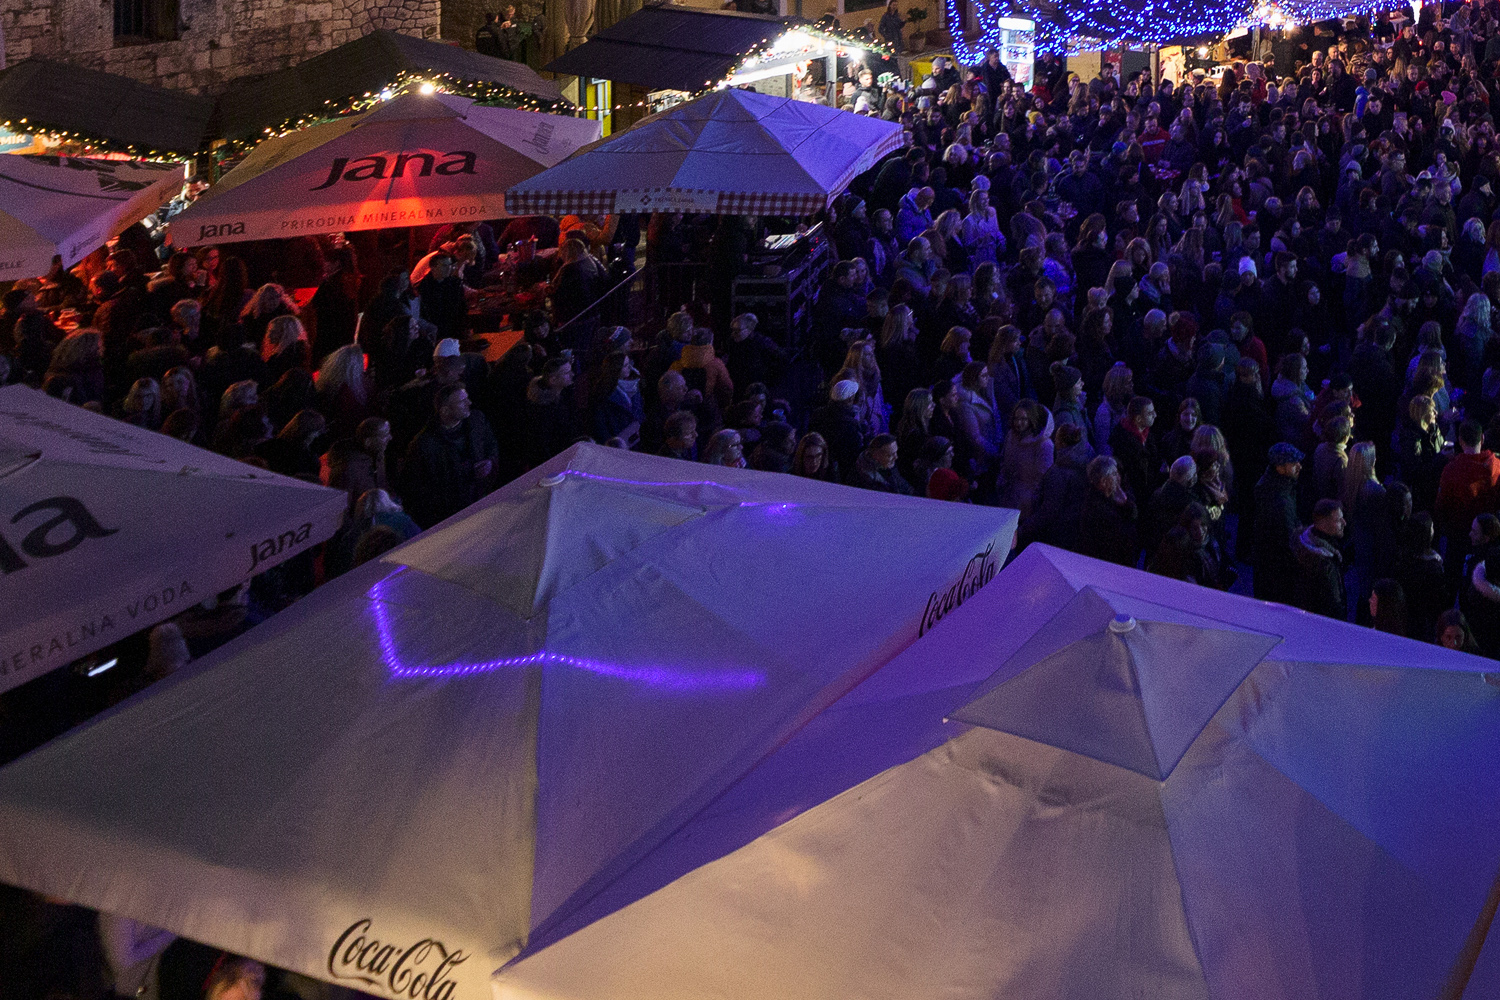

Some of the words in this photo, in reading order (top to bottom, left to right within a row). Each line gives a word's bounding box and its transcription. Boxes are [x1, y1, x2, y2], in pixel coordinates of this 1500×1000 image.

[309, 150, 478, 192] Jana
[281, 215, 355, 230] PRIRODNA
[362, 208, 443, 223] MINERALNA
[450, 204, 487, 216] VODA
[127, 580, 195, 619] VODA
